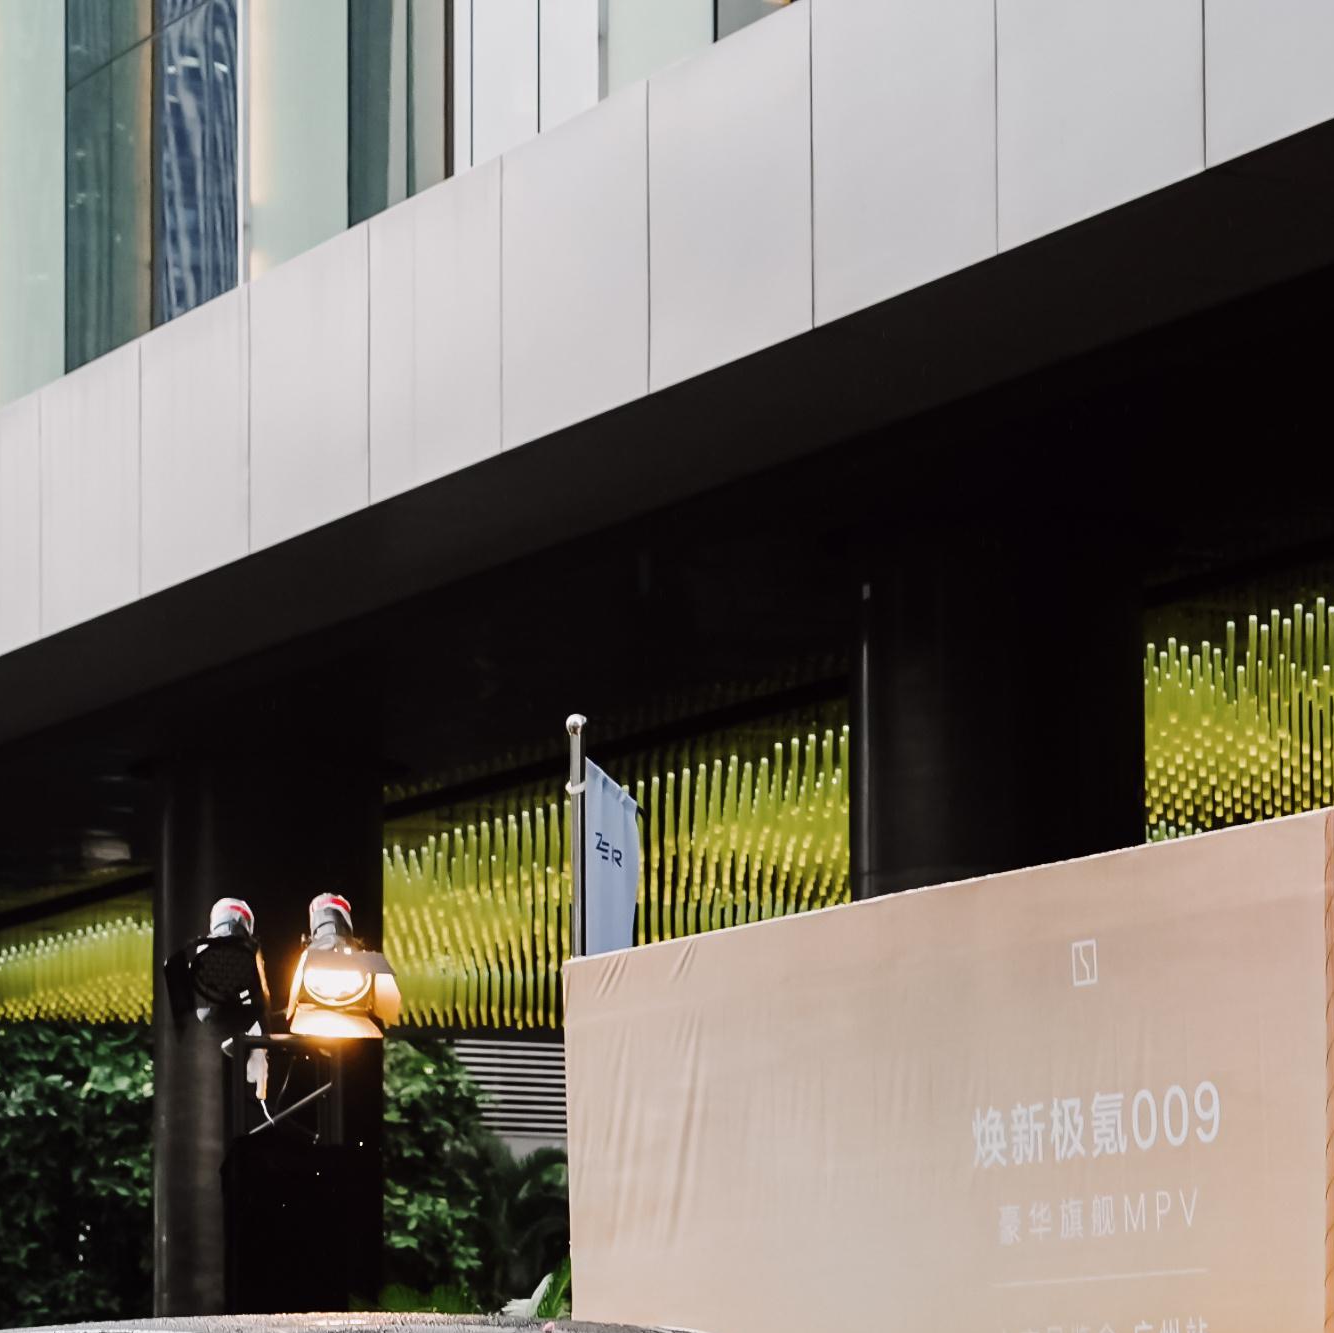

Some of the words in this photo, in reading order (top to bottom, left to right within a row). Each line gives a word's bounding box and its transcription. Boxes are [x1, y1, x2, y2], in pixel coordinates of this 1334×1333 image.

[972, 1081, 1220, 1168] 焕新极氪009
[999, 1187, 1198, 1246] 豪华旗舰MPV
